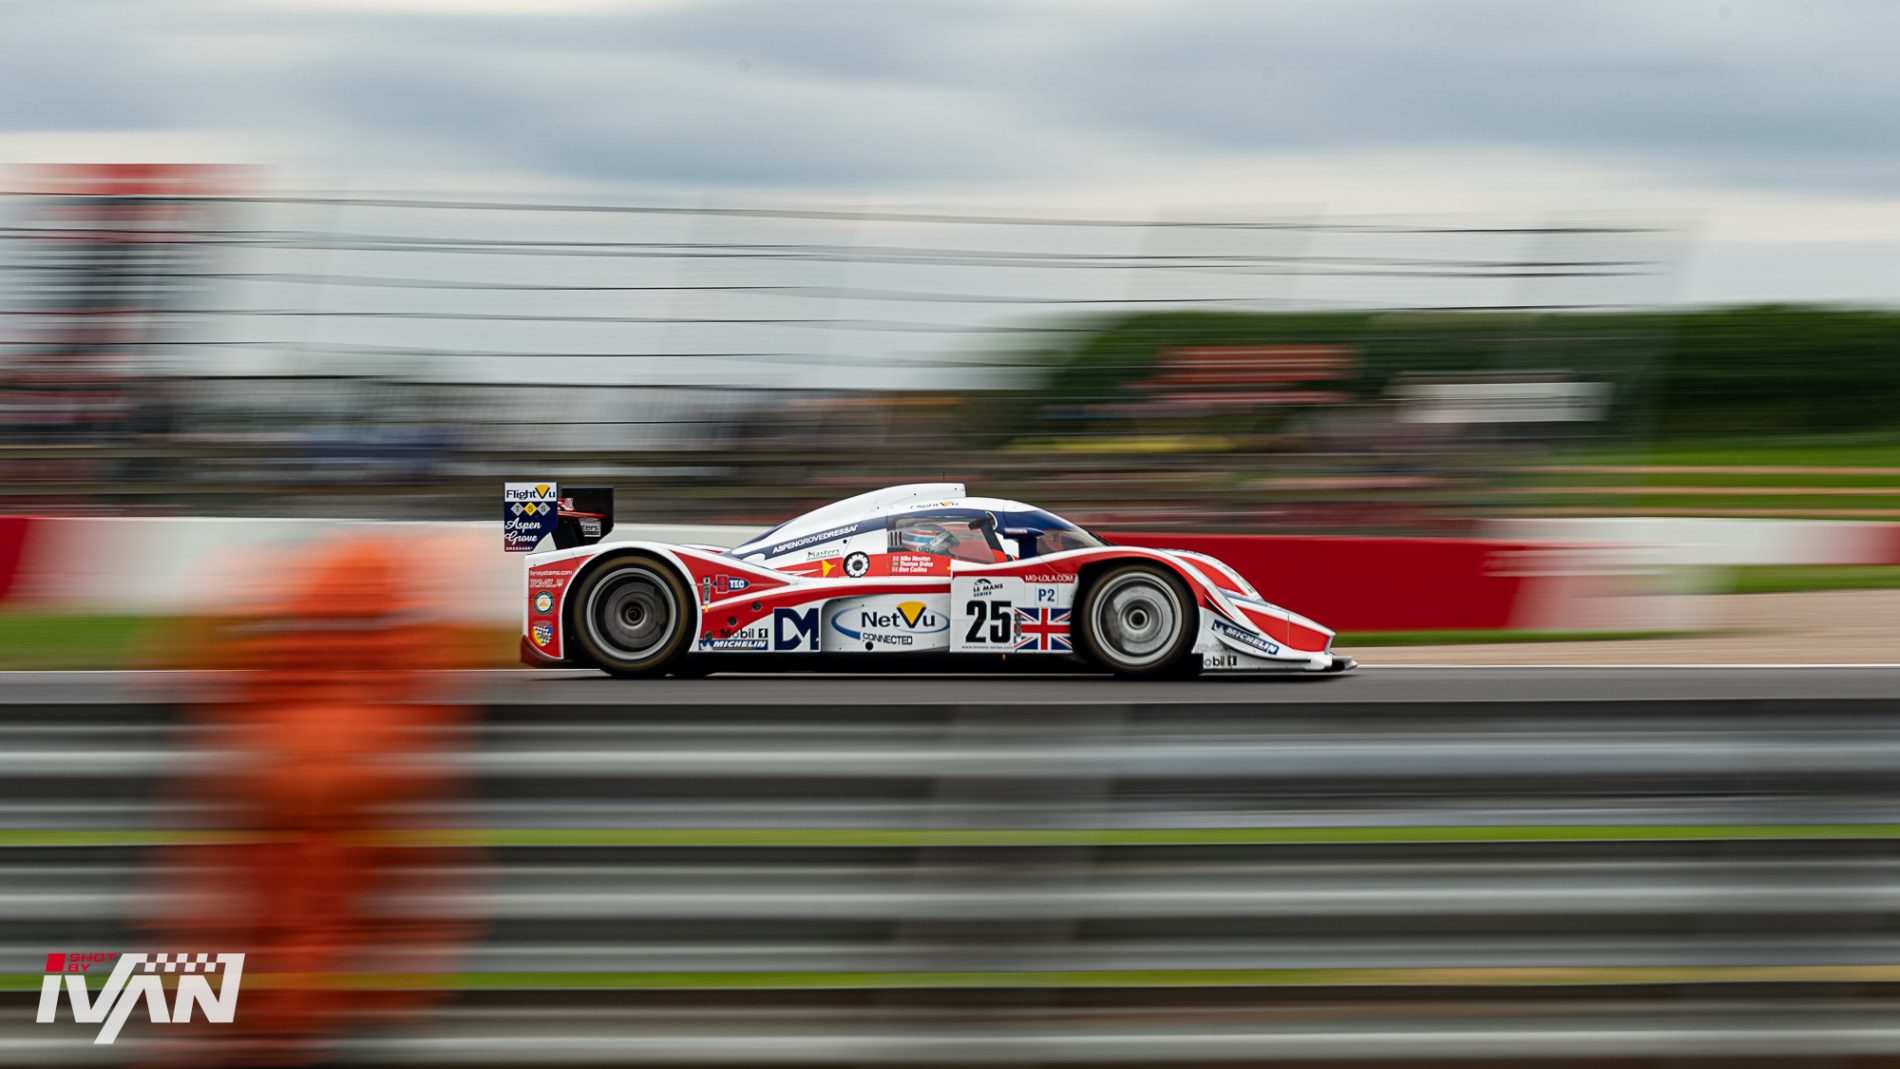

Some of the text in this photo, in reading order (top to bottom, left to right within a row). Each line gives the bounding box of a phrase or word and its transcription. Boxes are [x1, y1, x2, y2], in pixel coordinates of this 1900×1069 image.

[506, 484, 556, 500] FlightVu
[505, 517, 541, 534] Aspen
[505, 531, 539, 546] Grove
[1038, 589, 1055, 602] P2
[861, 601, 936, 629] NetVu
[965, 600, 1012, 643] 25
[720, 628, 755, 638] Mobil
[862, 633, 914, 645] CONNECTED
[1226, 627, 1278, 654] MICHELIN
[713, 640, 766, 648] MICHELIN
[1204, 656, 1225, 667] obil
